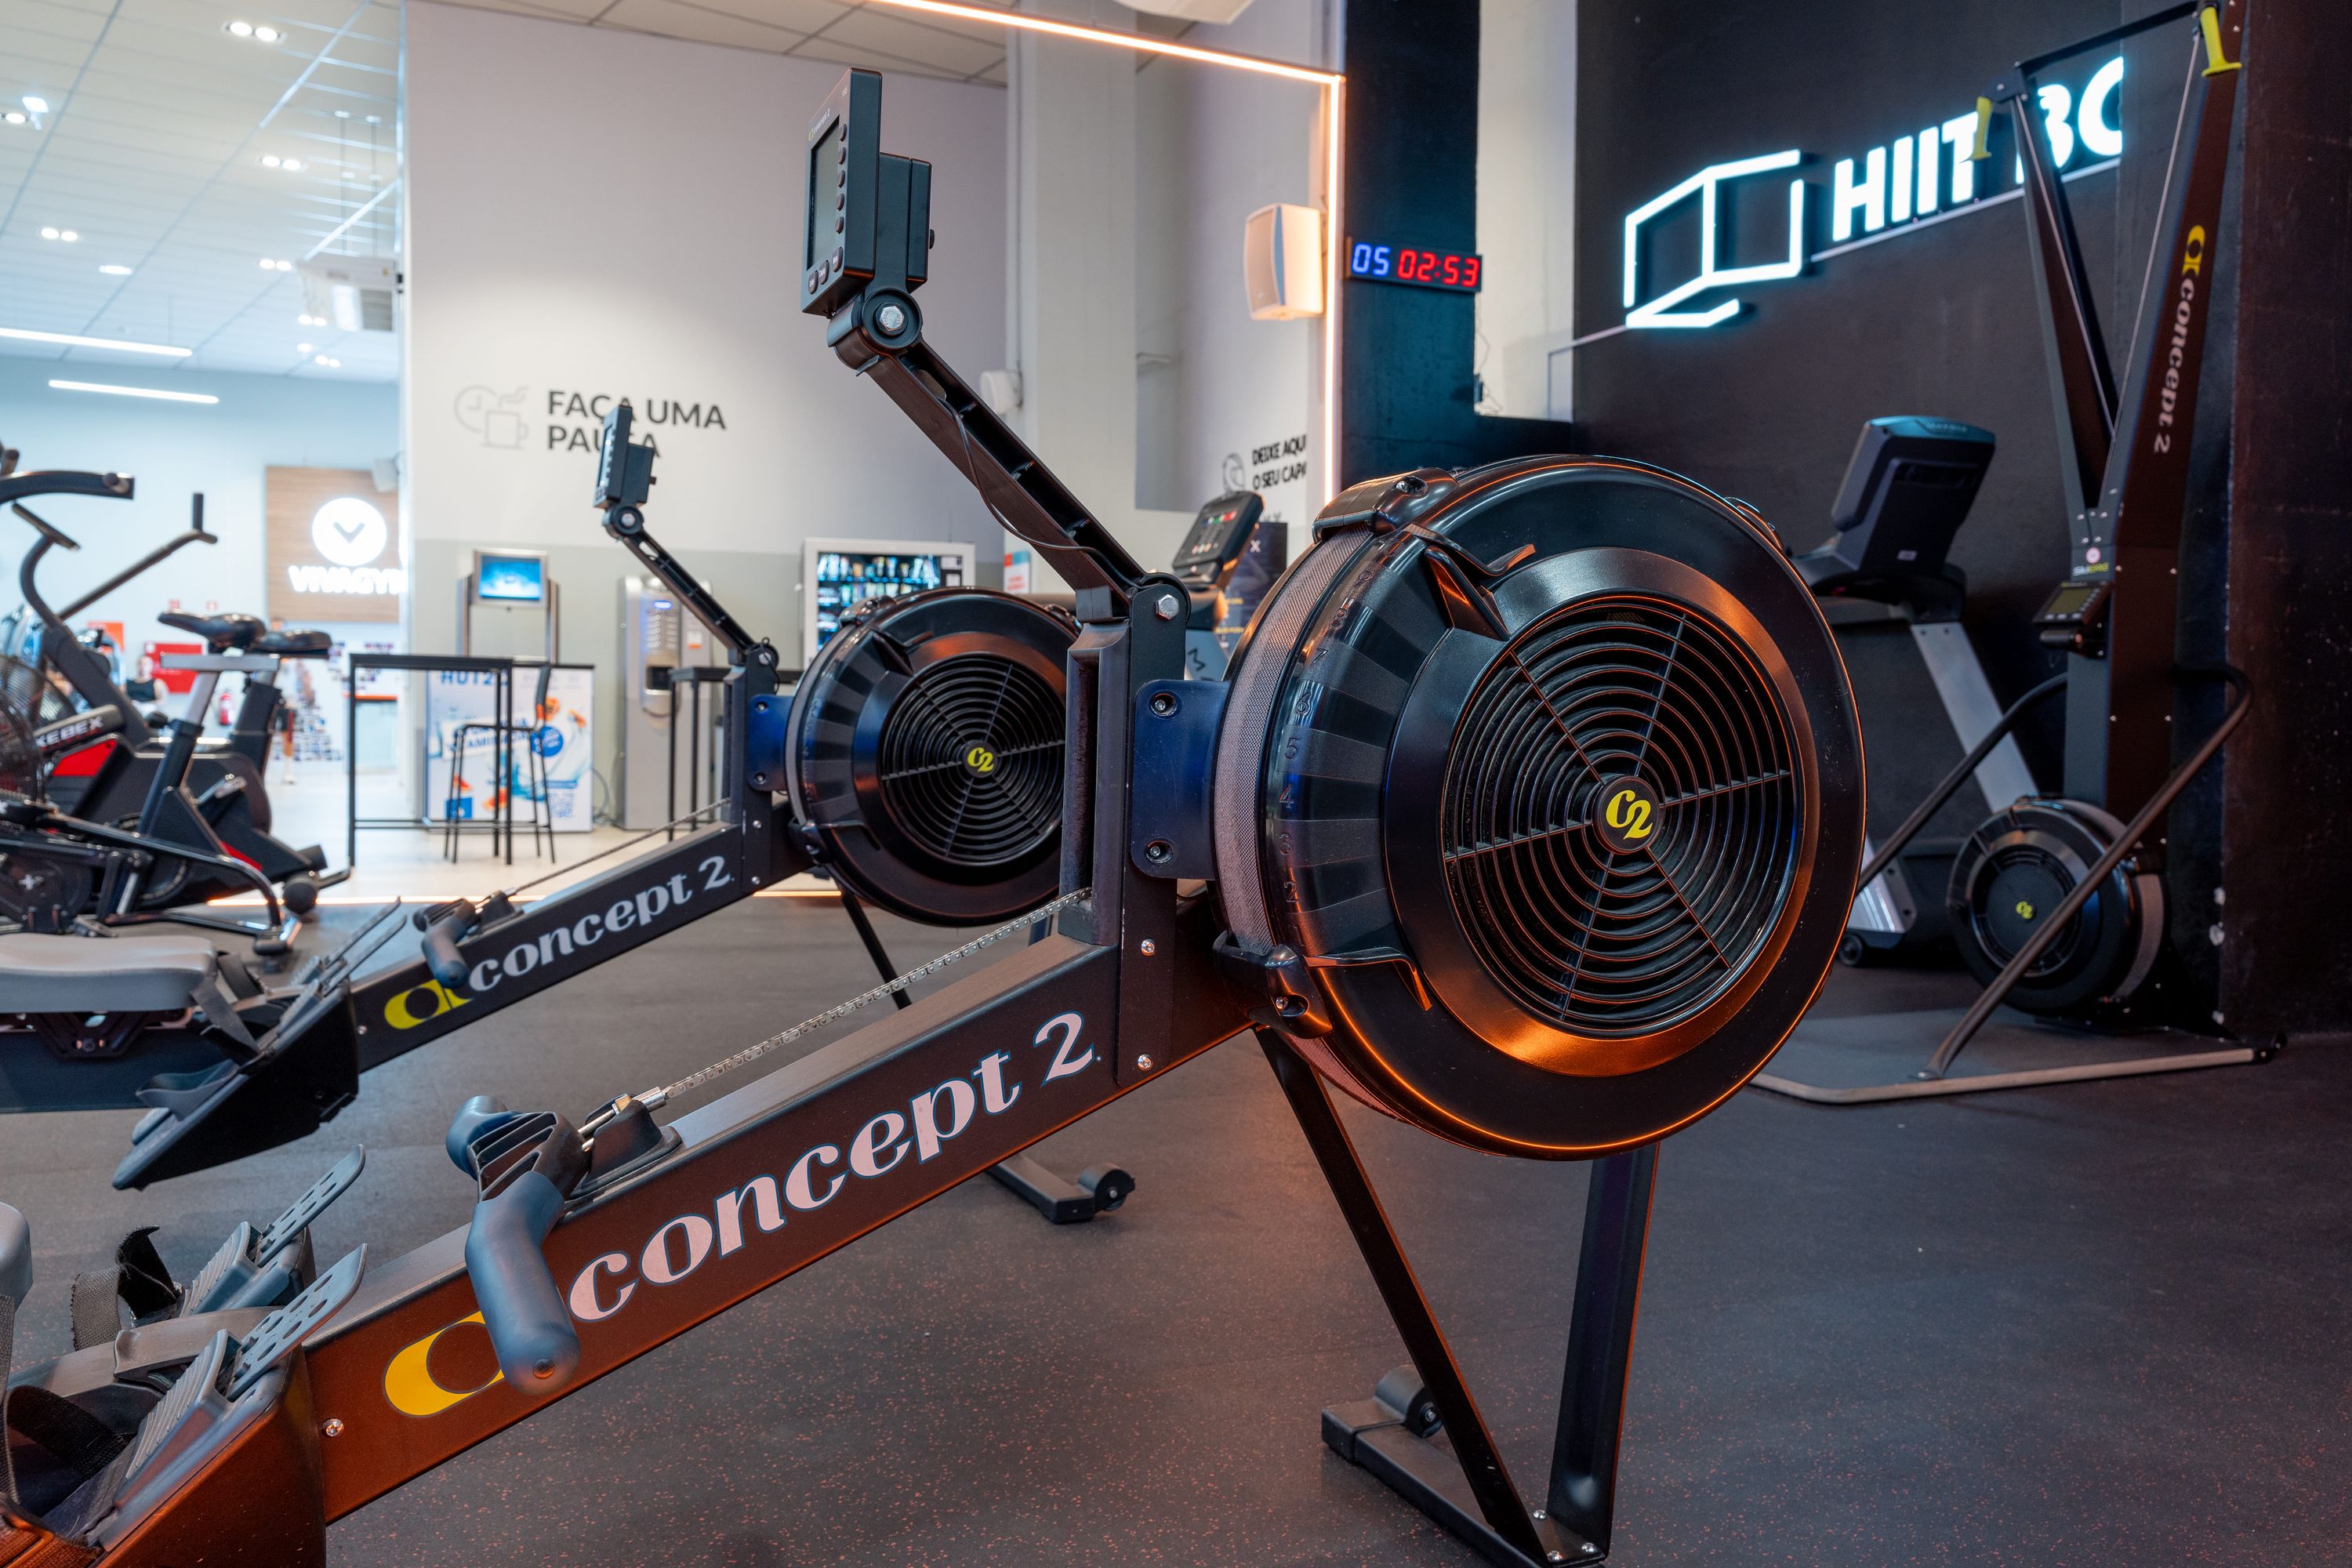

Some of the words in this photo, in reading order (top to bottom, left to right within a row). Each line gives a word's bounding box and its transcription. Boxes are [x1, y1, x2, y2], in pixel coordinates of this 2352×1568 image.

[1832, 111, 1978, 242] HIIT
[1352, 243, 1391, 276] 05
[1397, 249, 1480, 288] 02:53
[2158, 278, 2194, 427] concept
[647, 398, 727, 430] UMA
[547, 424, 661, 459] PAA
[2154, 433, 2171, 454] 2
[1262, 469, 1280, 488] SEU
[1606, 789, 1653, 840] C2
[470, 873, 694, 992] concept
[699, 855, 731, 891] 2
[568, 1048, 1021, 1323] concept
[1034, 1011, 1096, 1087] 2
